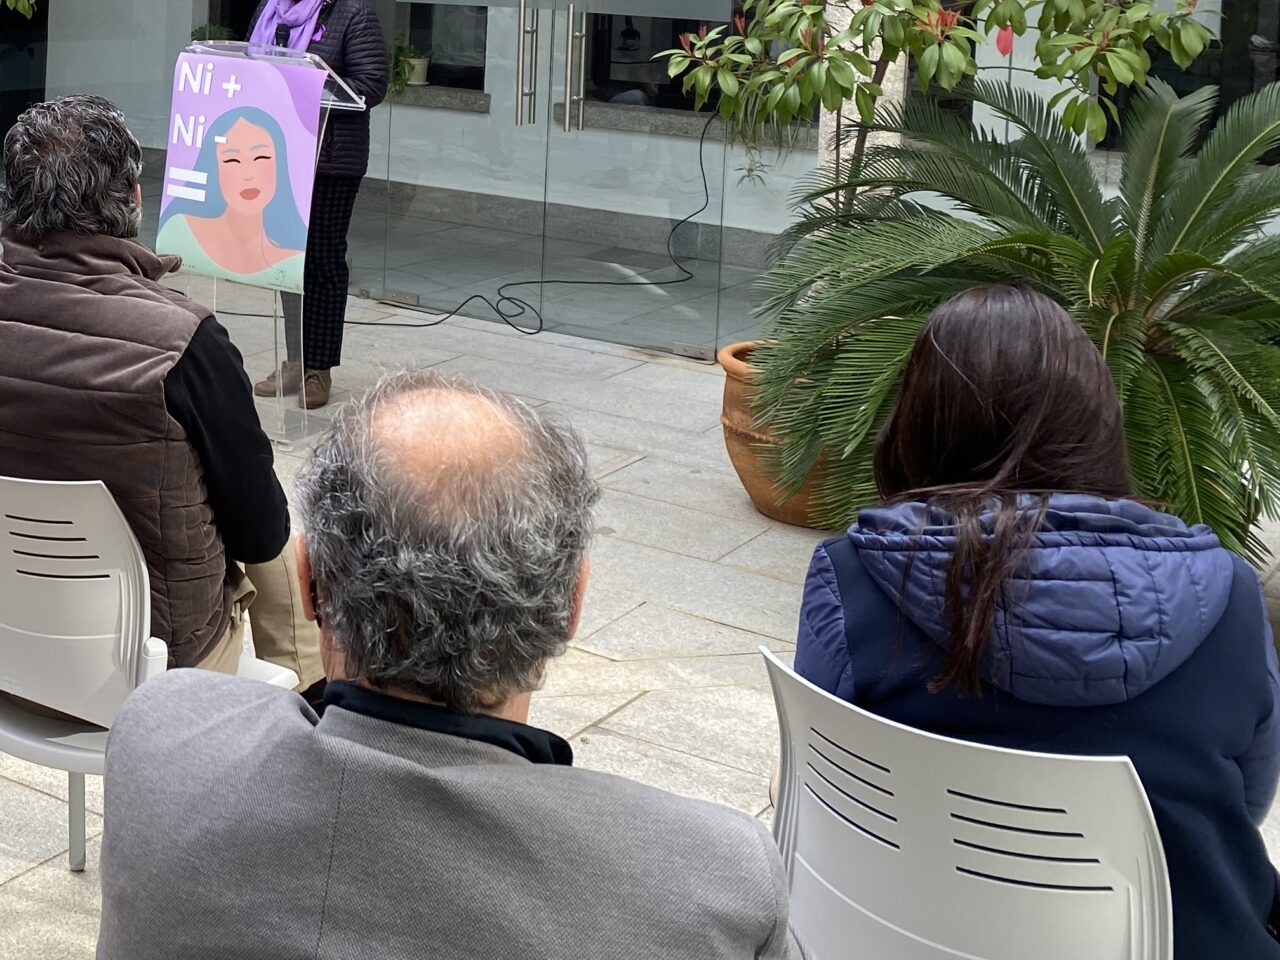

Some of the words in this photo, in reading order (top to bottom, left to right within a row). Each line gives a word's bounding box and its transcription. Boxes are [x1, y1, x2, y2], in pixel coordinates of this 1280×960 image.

[178, 61, 214, 96] Ni
[222, 75, 242, 99] +
[172, 113, 206, 148] Ni
